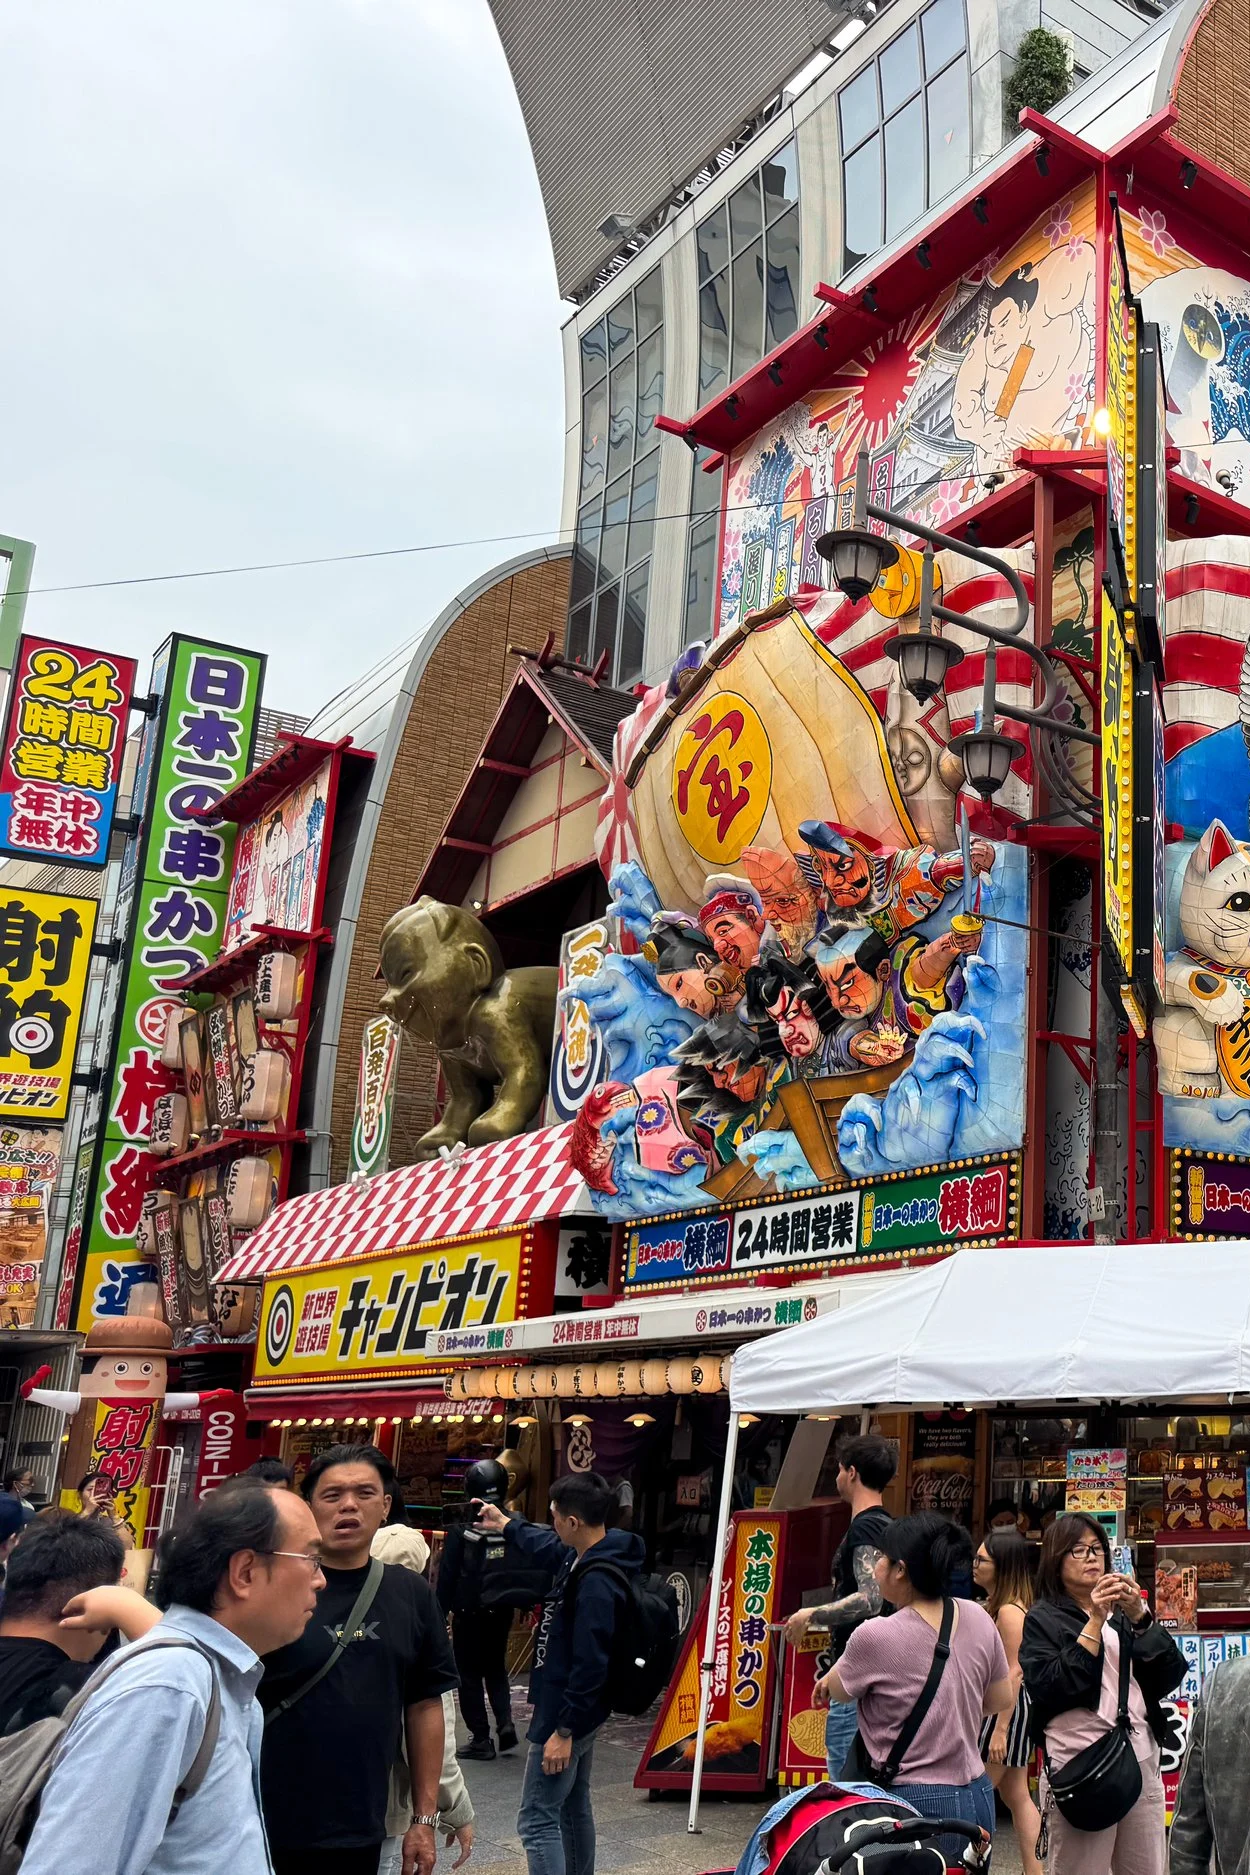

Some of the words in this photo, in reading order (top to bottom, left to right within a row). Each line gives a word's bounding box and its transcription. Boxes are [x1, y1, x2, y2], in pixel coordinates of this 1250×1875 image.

[26, 651, 120, 709] 24
[23, 702, 113, 750] 時間
[17, 743, 108, 788] 営業
[16, 788, 99, 824] 年中
[15, 816, 98, 853] 無休
[363, 1020, 390, 1130] 百発百中
[861, 1193, 875, 1247] 新世界
[873, 1196, 938, 1229] 日本一の串かつ
[938, 1168, 1005, 1235] 横綱
[1187, 1165, 1205, 1225] 新世界
[637, 1239, 683, 1267] 日本一の串かつ
[683, 1217, 730, 1271] 横綱
[736, 1201, 855, 1261] 24時間営業
[302, 1290, 338, 1320] 新世界
[339, 1255, 509, 1358] チャンピオン
[552, 1320, 602, 1344] 24時間営業
[604, 1317, 640, 1337] 年中無休
[708, 1308, 772, 1328] 日本一の串かつ
[774, 1299, 803, 1325] 横綱
[294, 1323, 333, 1354] 遊技場
[96, 1405, 151, 1489] 射的
[734, 1527, 775, 1709] 本場の串かつ
